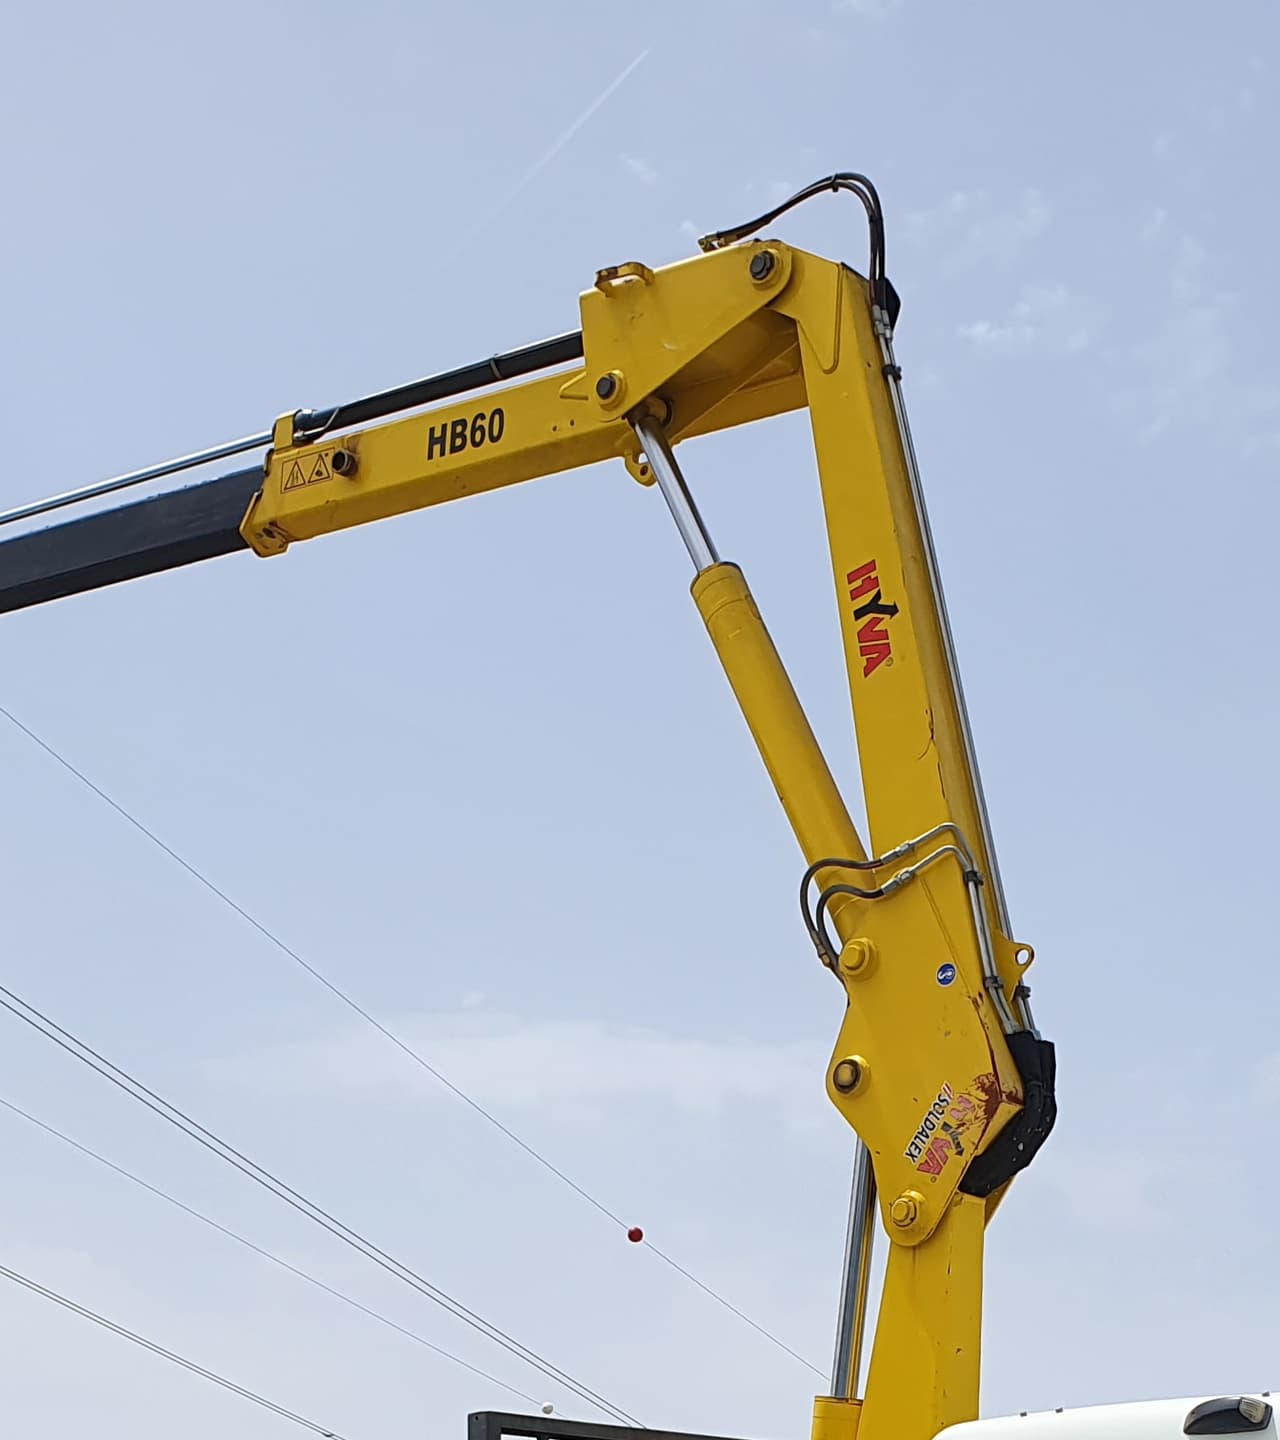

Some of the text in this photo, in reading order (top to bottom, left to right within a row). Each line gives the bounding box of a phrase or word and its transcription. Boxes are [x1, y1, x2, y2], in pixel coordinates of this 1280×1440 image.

[426, 408, 504, 460] HB60
[846, 559, 899, 678] HYVA
[904, 1092, 953, 1163] SOLDALEX
